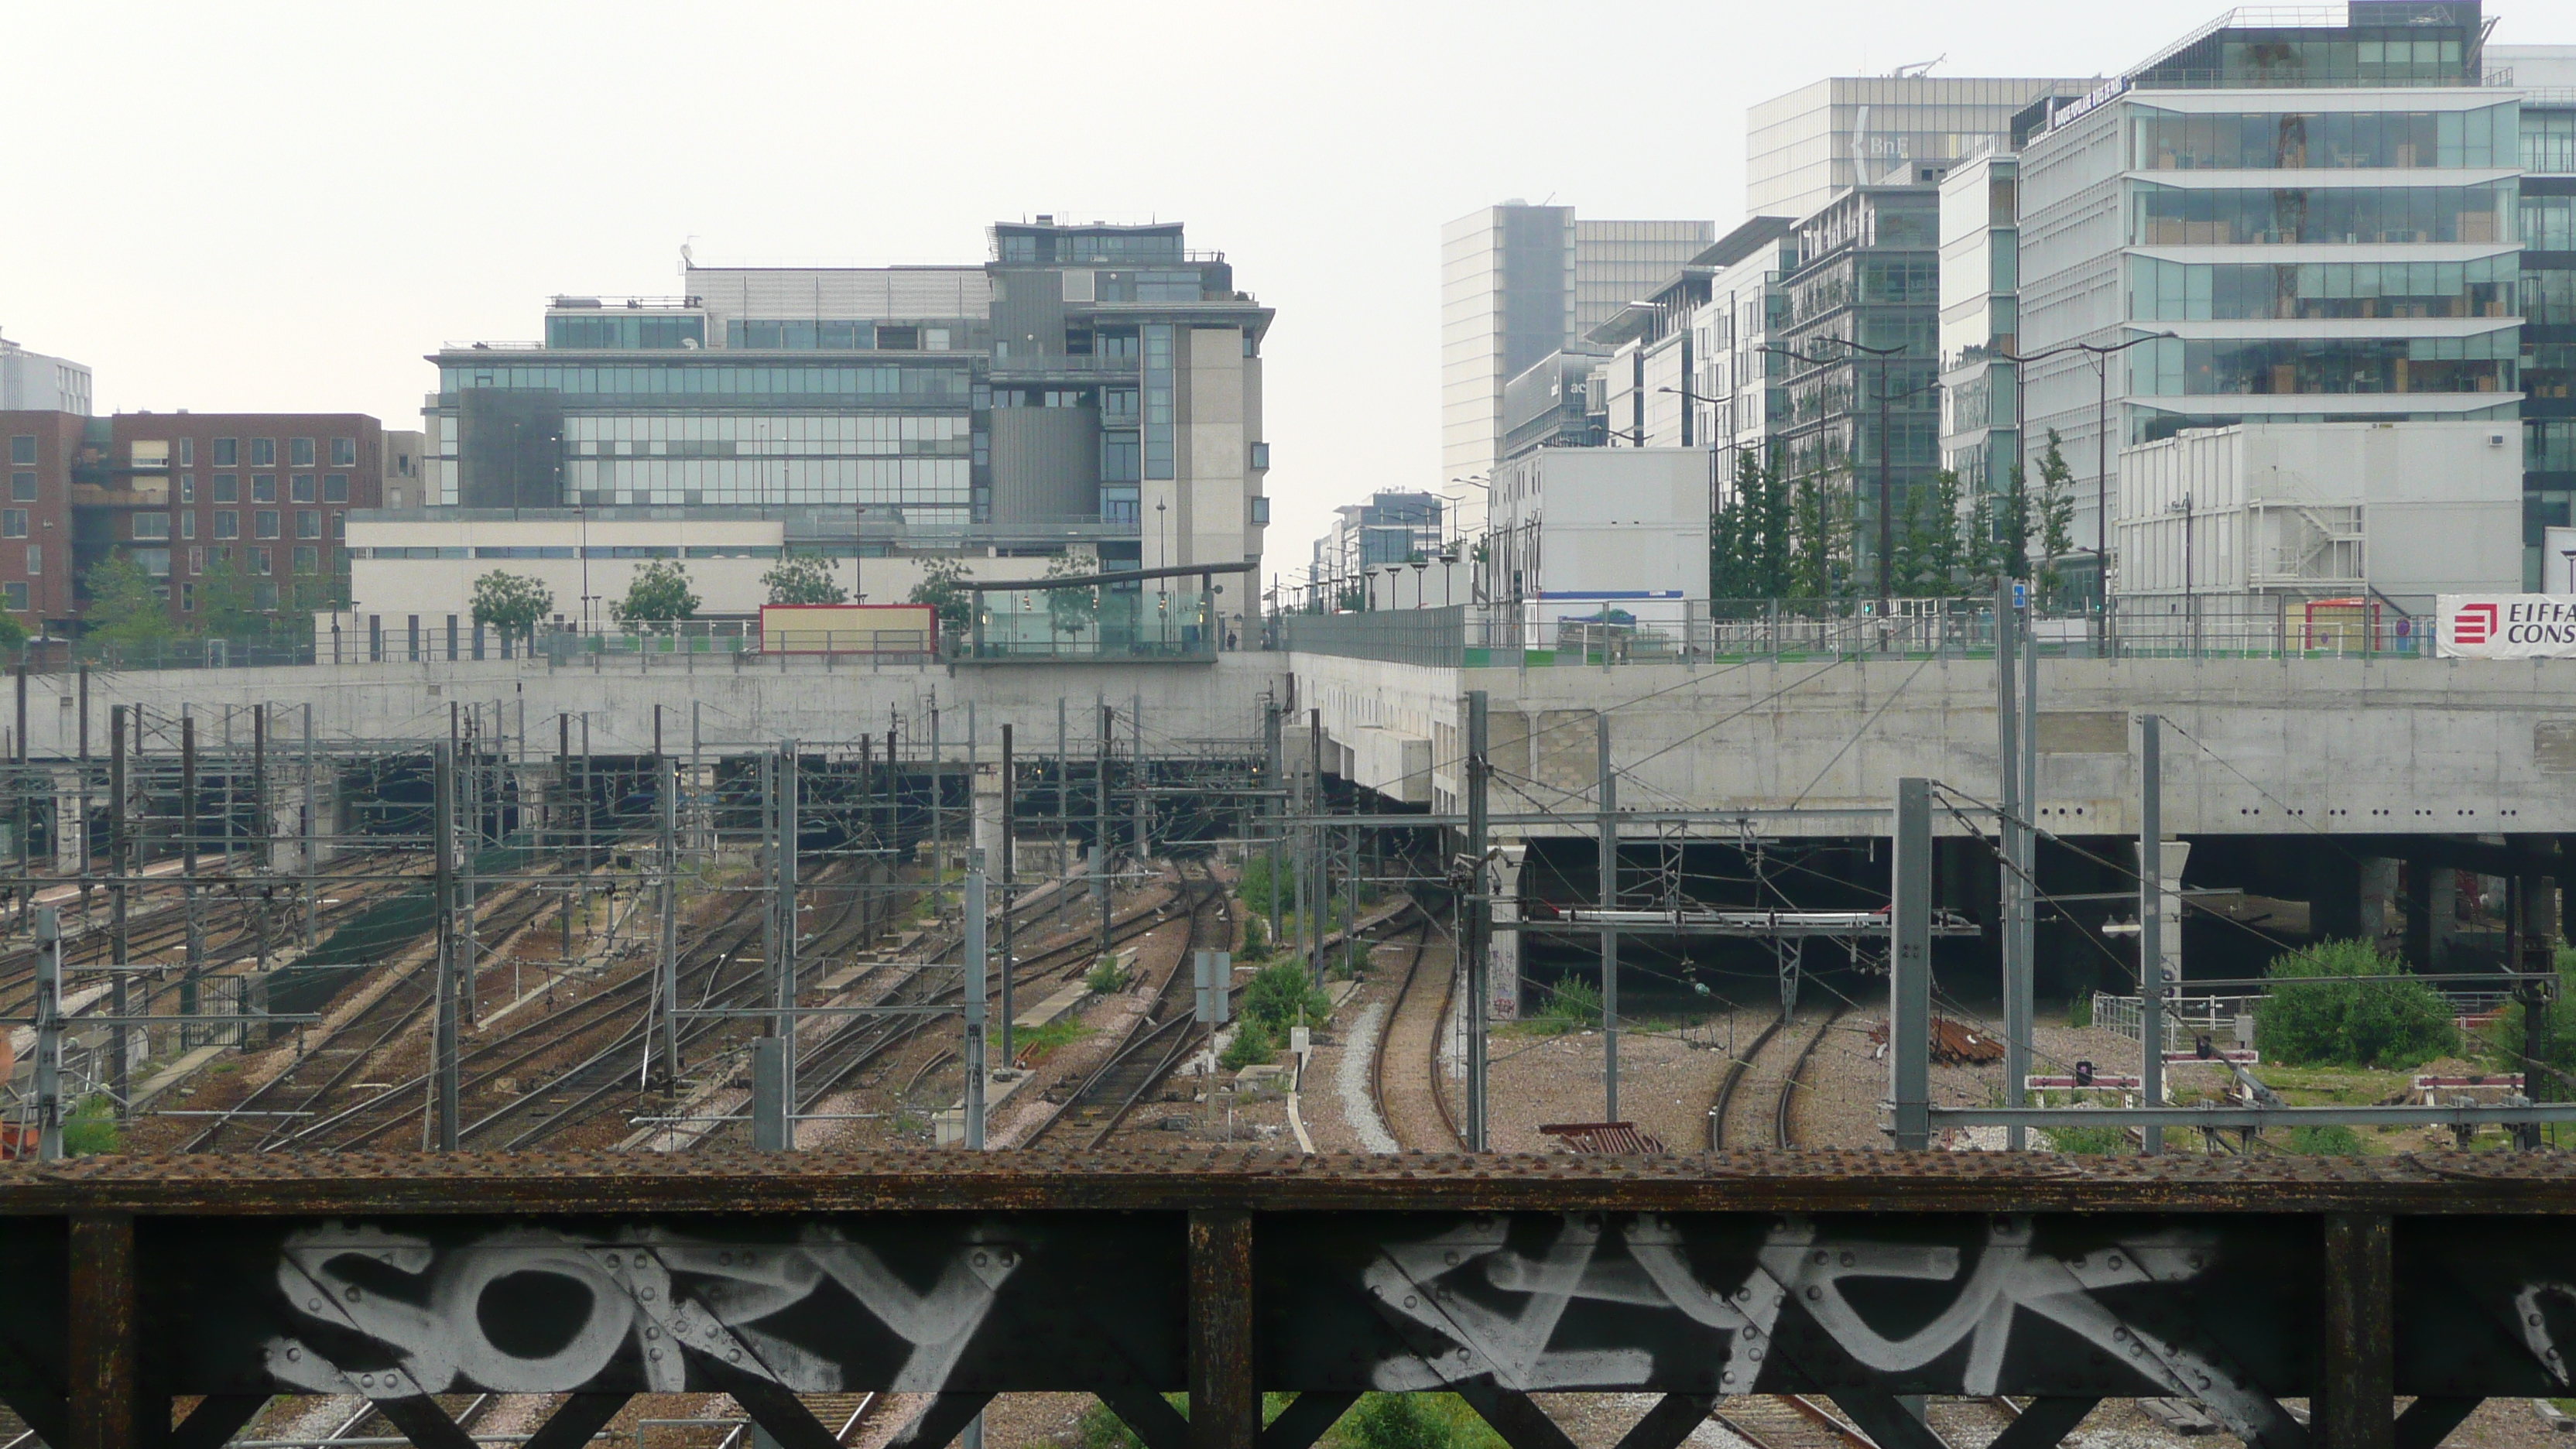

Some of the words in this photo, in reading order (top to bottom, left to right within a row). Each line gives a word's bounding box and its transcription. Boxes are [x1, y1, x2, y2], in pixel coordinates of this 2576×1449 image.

[1871, 137, 1909, 154] BnF
[2509, 603, 2576, 622] EIFFA
[2508, 624, 2575, 644] CONS
